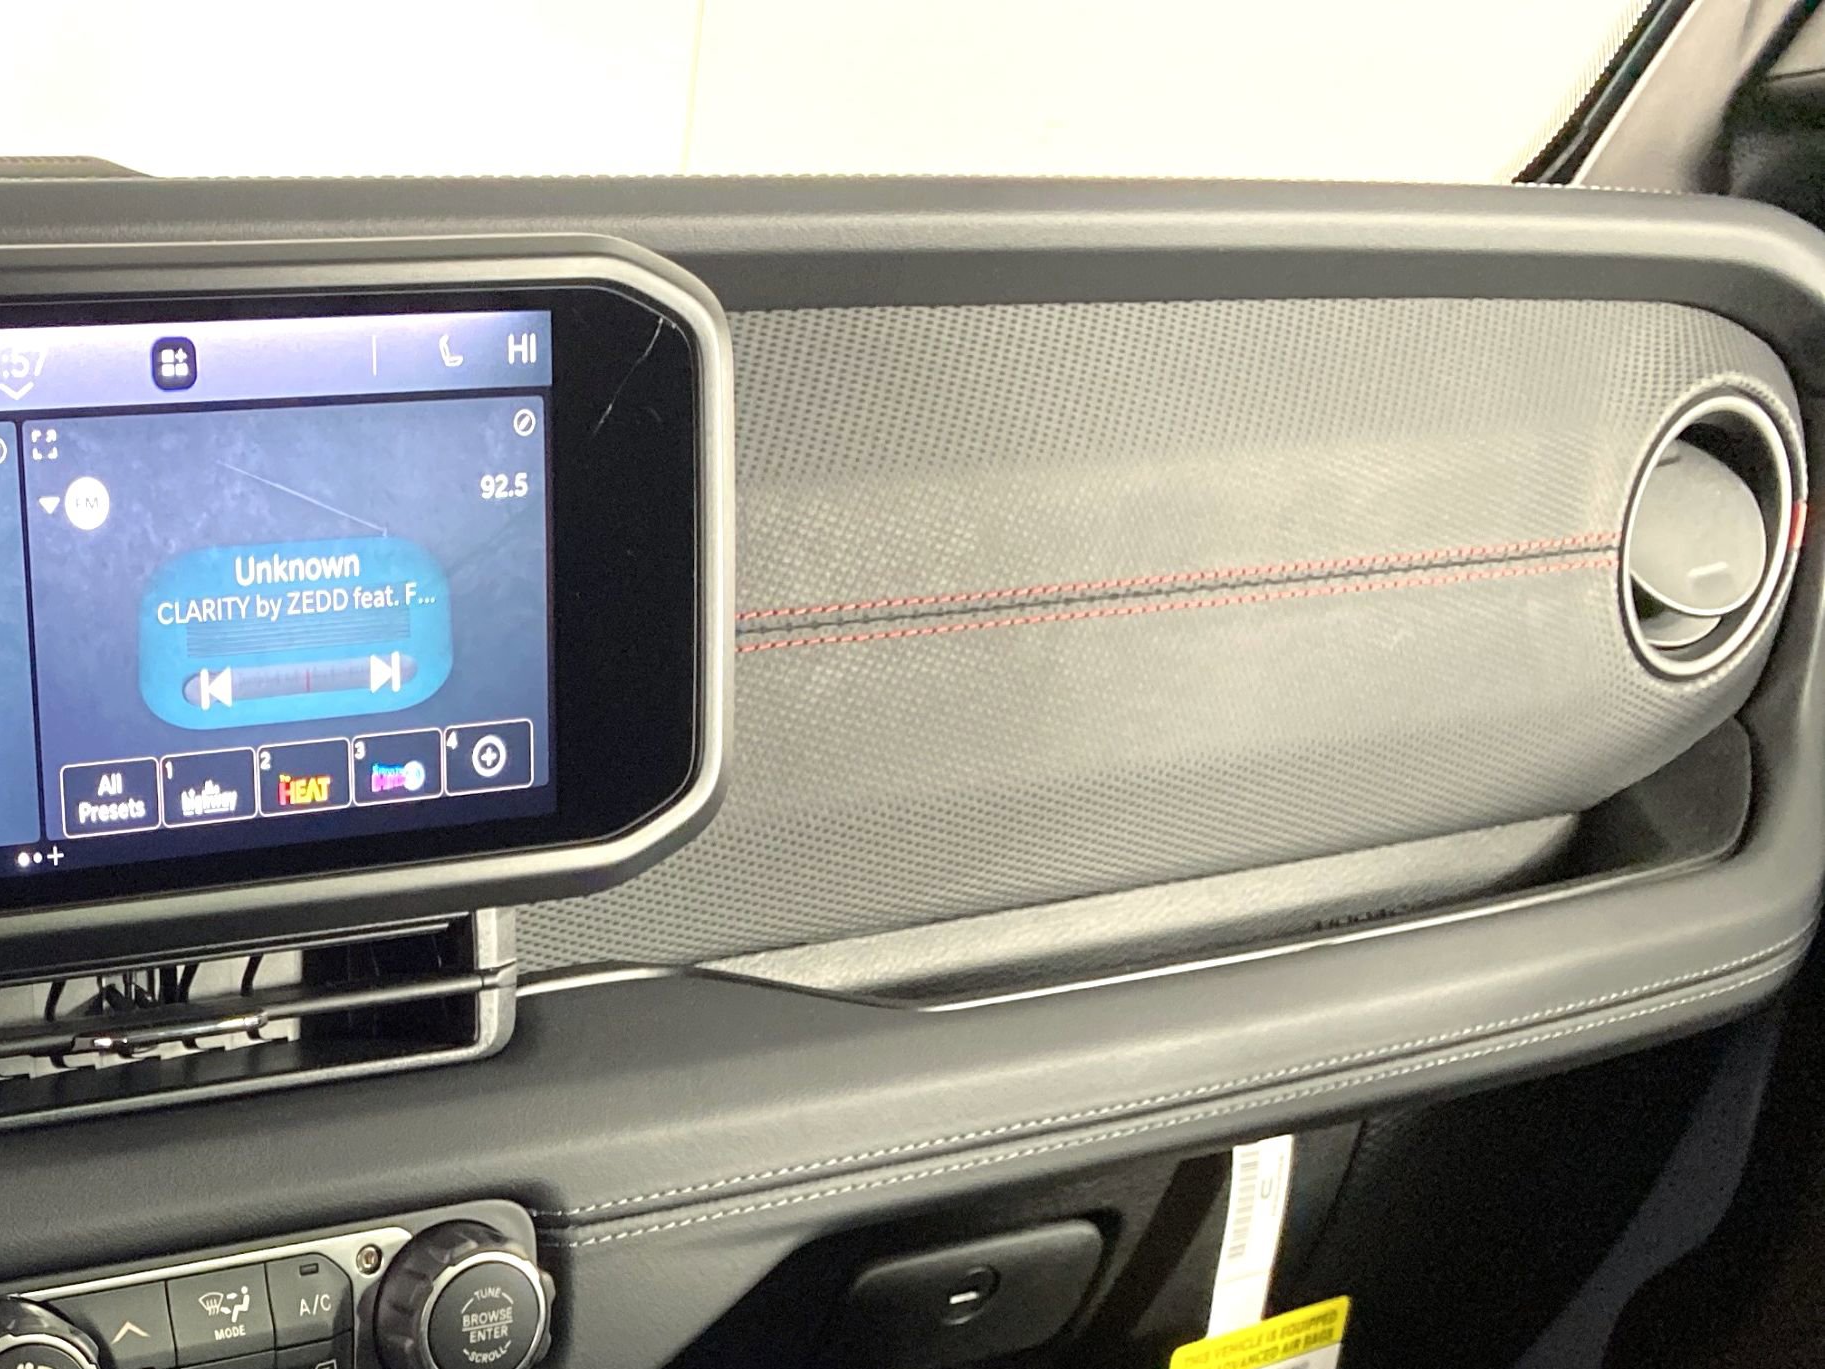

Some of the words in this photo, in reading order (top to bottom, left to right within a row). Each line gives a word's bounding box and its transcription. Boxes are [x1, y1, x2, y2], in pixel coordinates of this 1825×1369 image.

[507, 335, 537, 365] HI
[480, 474, 529, 501] 92.5
[234, 553, 361, 587] Unknown
[156, 596, 250, 625] CLARITY
[256, 595, 281, 622] by
[286, 588, 349, 615] ZEDD
[353, 585, 400, 609] feat.
[354, 741, 366, 760] 3
[446, 731, 459, 750] 4
[164, 760, 174, 780] 1
[260, 751, 272, 770] 2
[97, 772, 123, 797] All
[278, 776, 332, 806] HEAT
[78, 797, 146, 824] Presets
[298, 1292, 332, 1316] A/C
[473, 1286, 502, 1301] TUNE
[462, 1306, 513, 1328] BROWSE
[213, 1323, 247, 1341] MODE
[469, 1325, 509, 1344] ENTER
[468, 1345, 508, 1364] SCROLL
